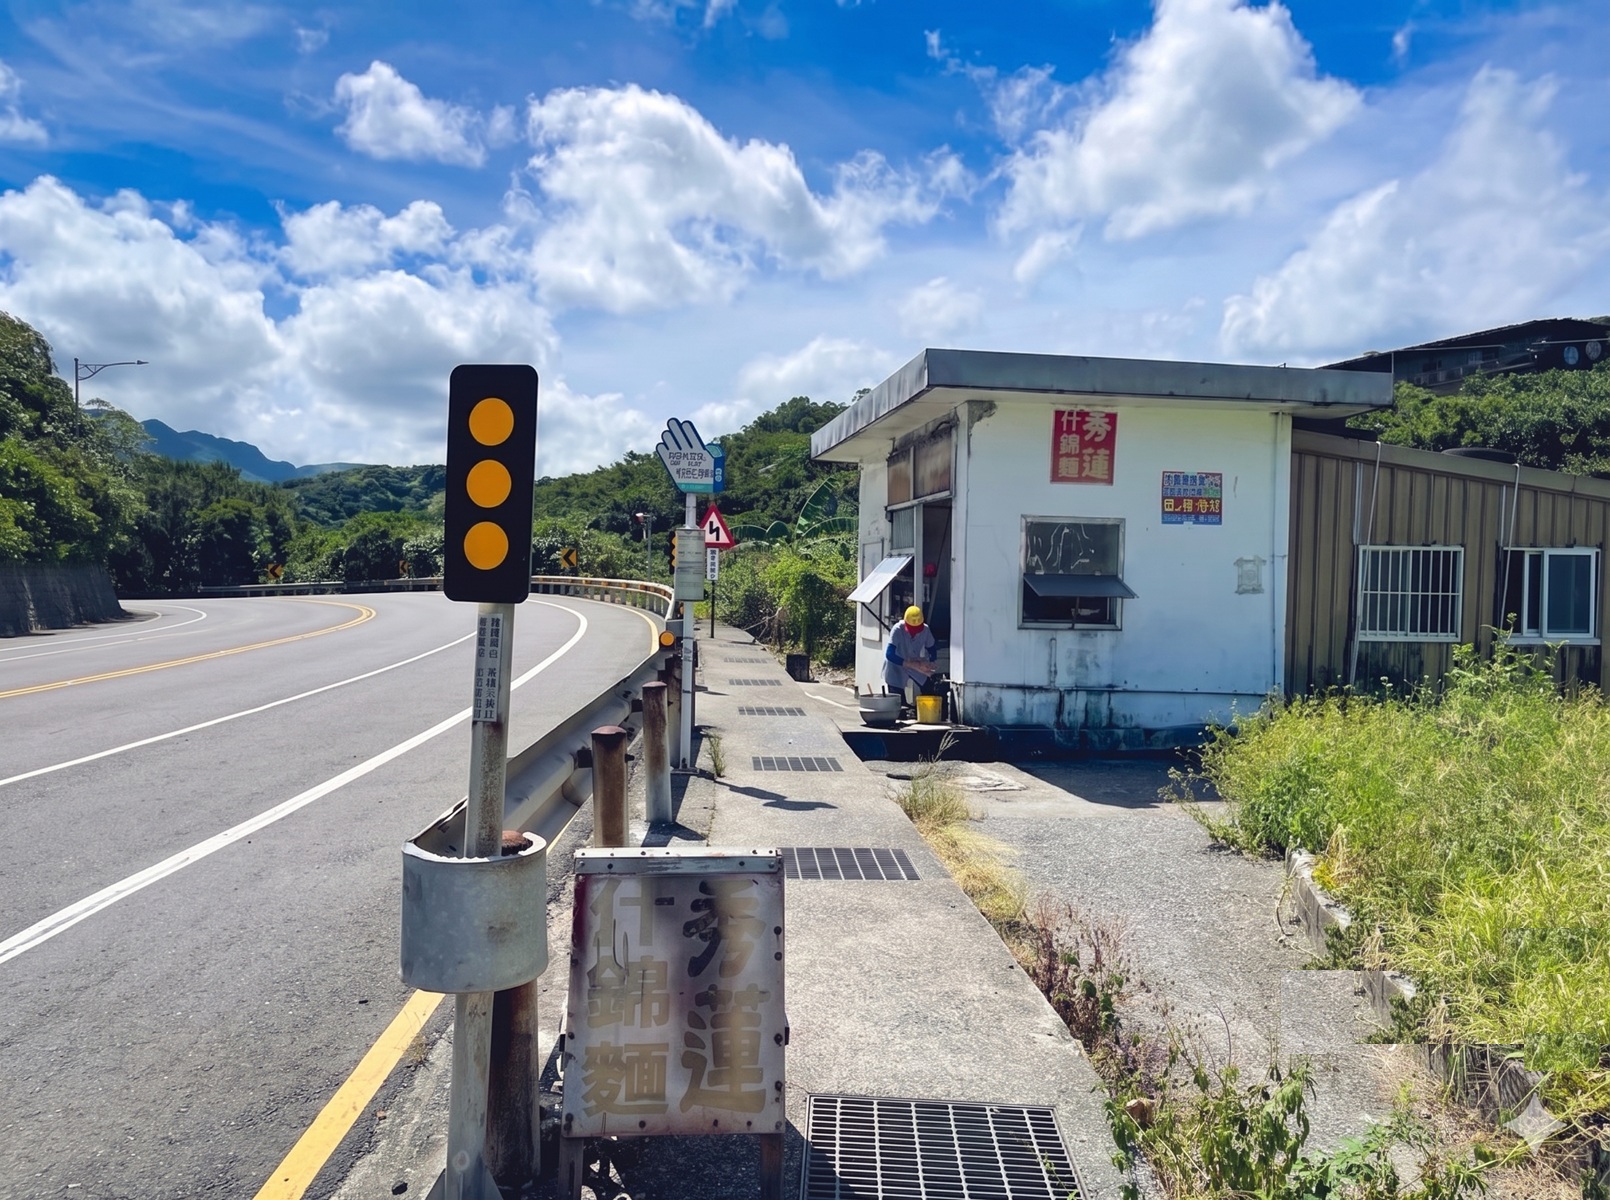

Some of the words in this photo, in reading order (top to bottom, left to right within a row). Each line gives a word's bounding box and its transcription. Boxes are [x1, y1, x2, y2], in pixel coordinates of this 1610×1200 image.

[1082, 412, 1112, 479] 秀蓮
[582, 879, 670, 1116] 什錦麵
[680, 879, 769, 1114] 秀蓮
